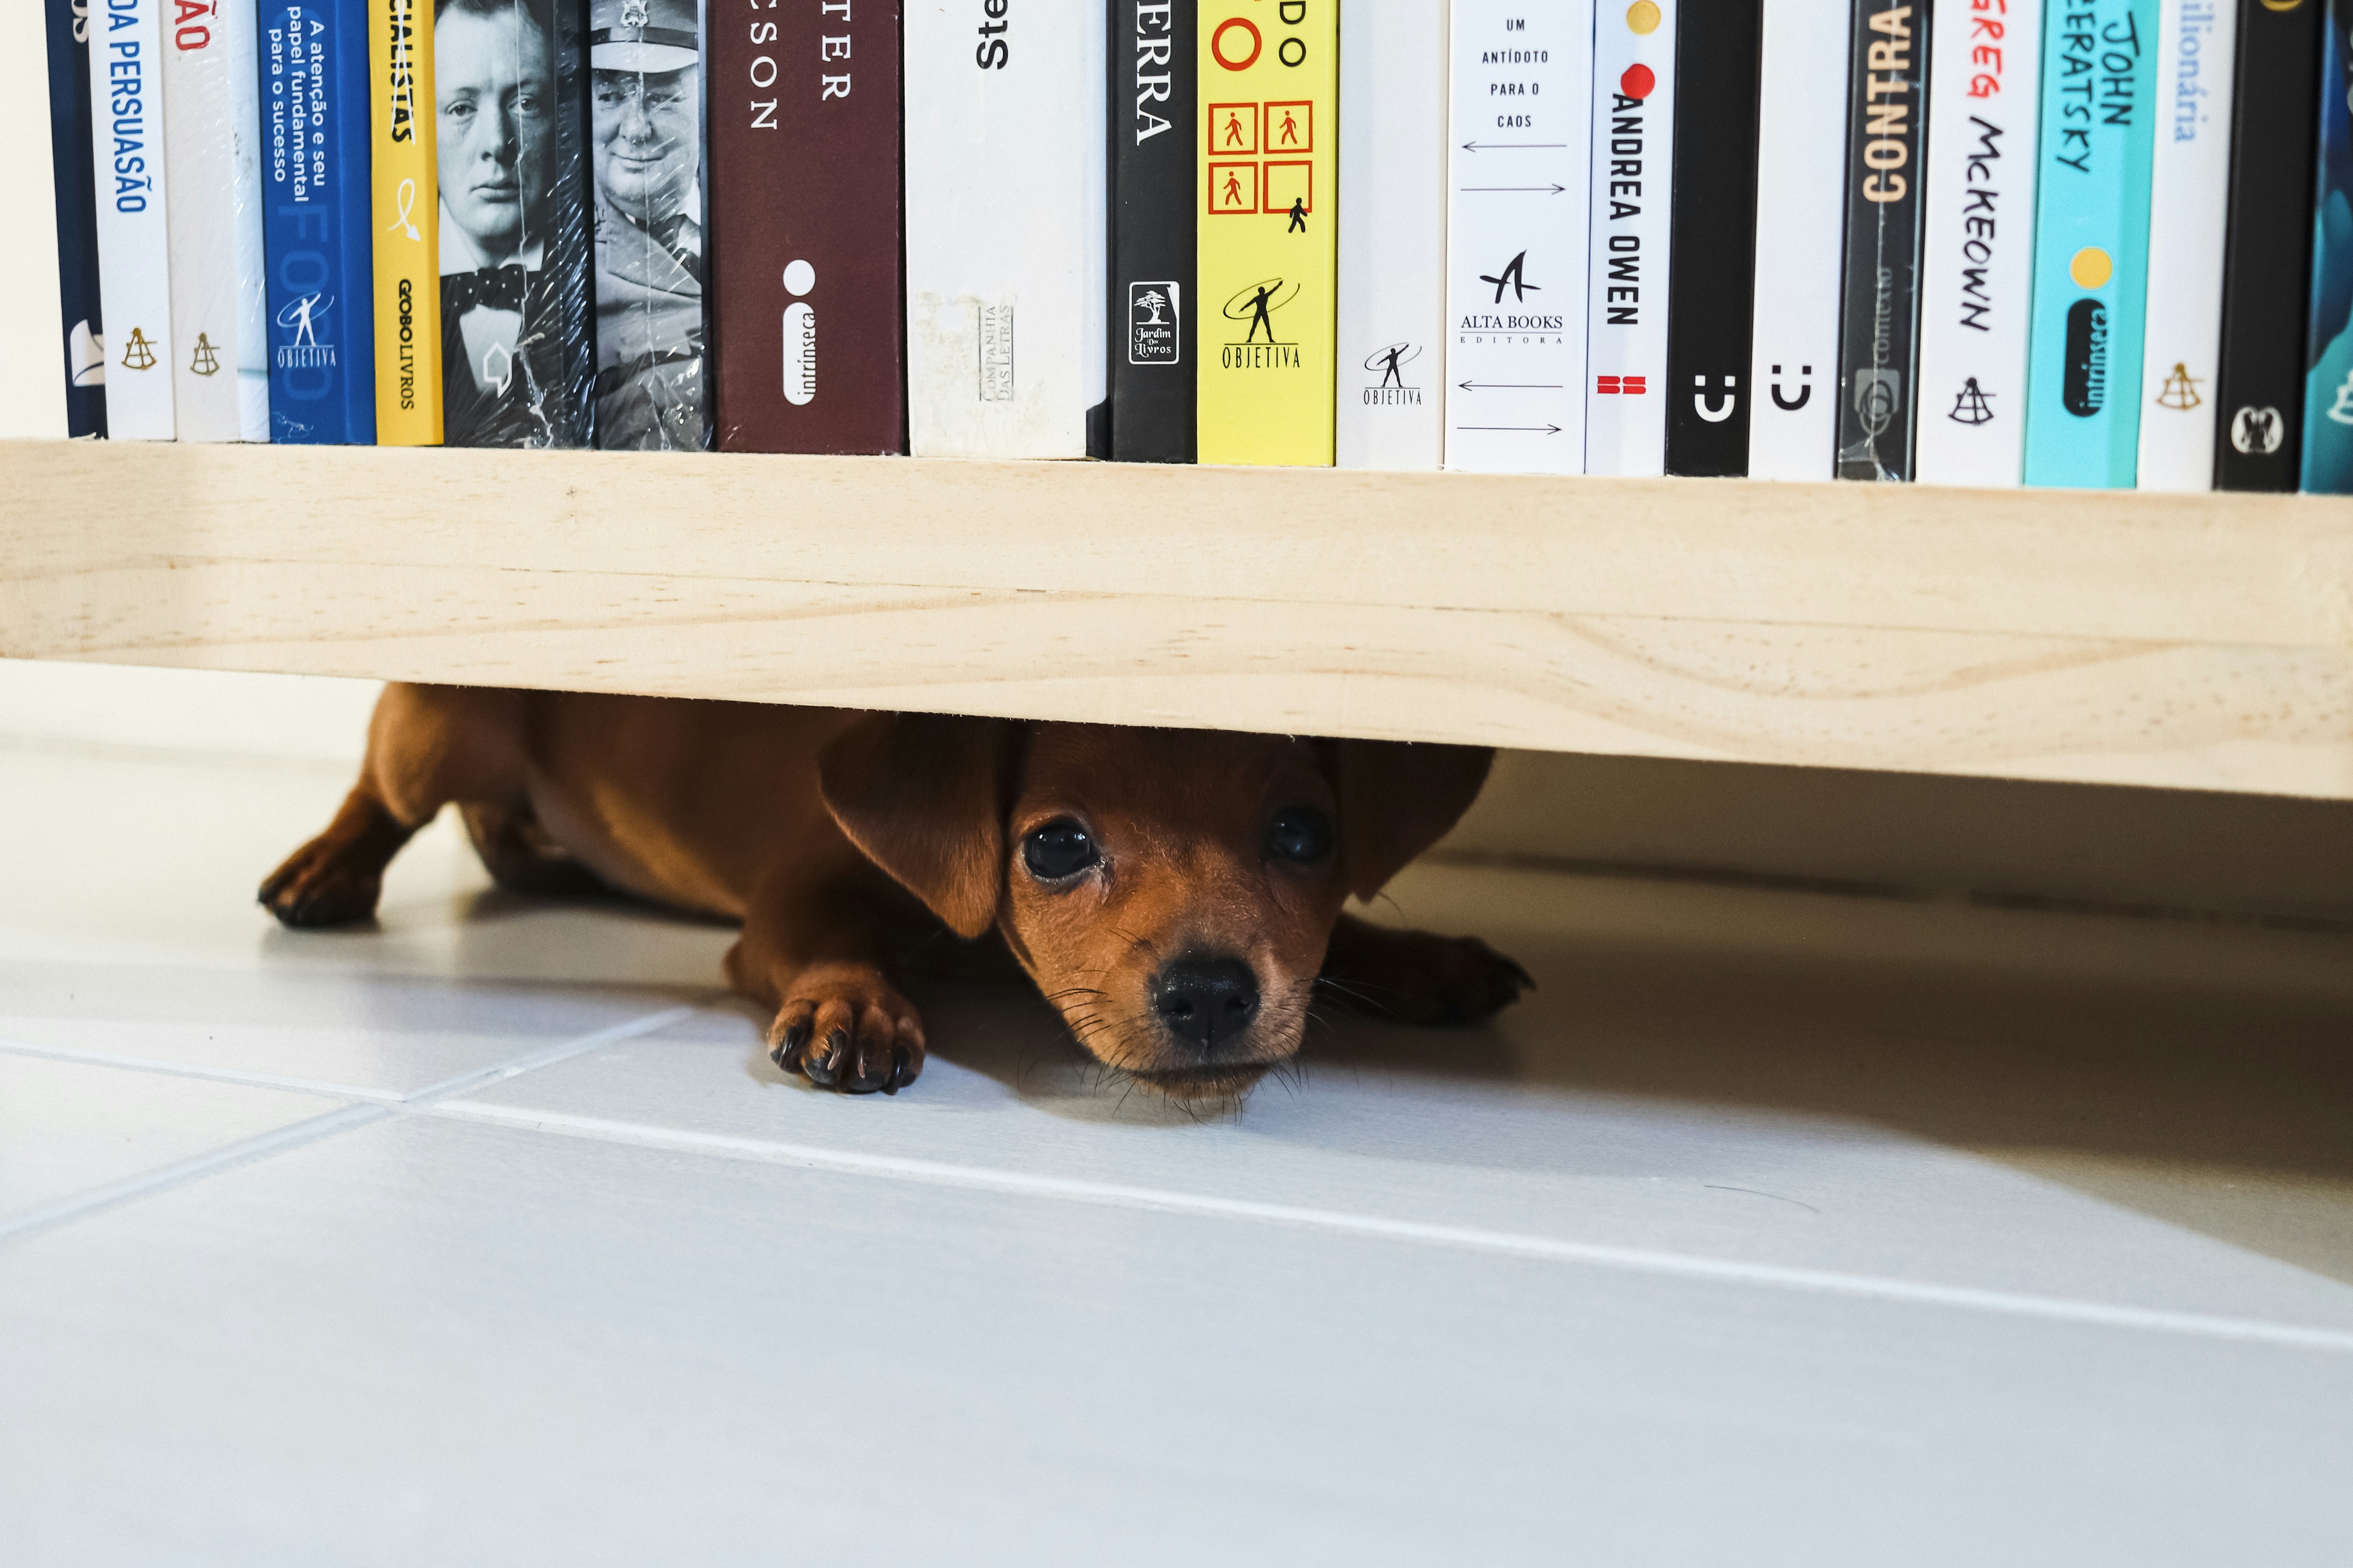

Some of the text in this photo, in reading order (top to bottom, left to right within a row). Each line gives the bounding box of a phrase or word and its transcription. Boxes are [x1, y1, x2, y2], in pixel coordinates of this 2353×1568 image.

[822, 0, 850, 100] TER
[976, 0, 1008, 69] Ste
[1483, 49, 1547, 63] ANTÍDOTO
[1507, 20, 1524, 30] UM
[268, 29, 285, 182] para o sucesso
[287, 7, 309, 202] papel fundamental
[310, 21, 327, 185] A atenção e seu
[1137, 0, 1172, 146] ERRA
[1491, 84, 1538, 95] PARA O
[1863, 4, 1912, 203] CONTRA
[2057, 0, 2095, 172] ERATSKY
[2101, 11, 2140, 125] JOHN
[110, 42, 151, 212] PERSUASÃO
[1498, 116, 1531, 127] CAOS
[1608, 93, 1644, 324] ANDREA OWEN
[277, 349, 336, 368] OBJETIVA
[797, 312, 816, 395] intrínseca
[1135, 327, 1171, 343] Jardim
[1135, 343, 1171, 358] Livros
[1223, 347, 1299, 368] OBJETIVA
[1461, 316, 1562, 328] ALTA BOOKS
[1364, 390, 1421, 405] OBJETIVA
